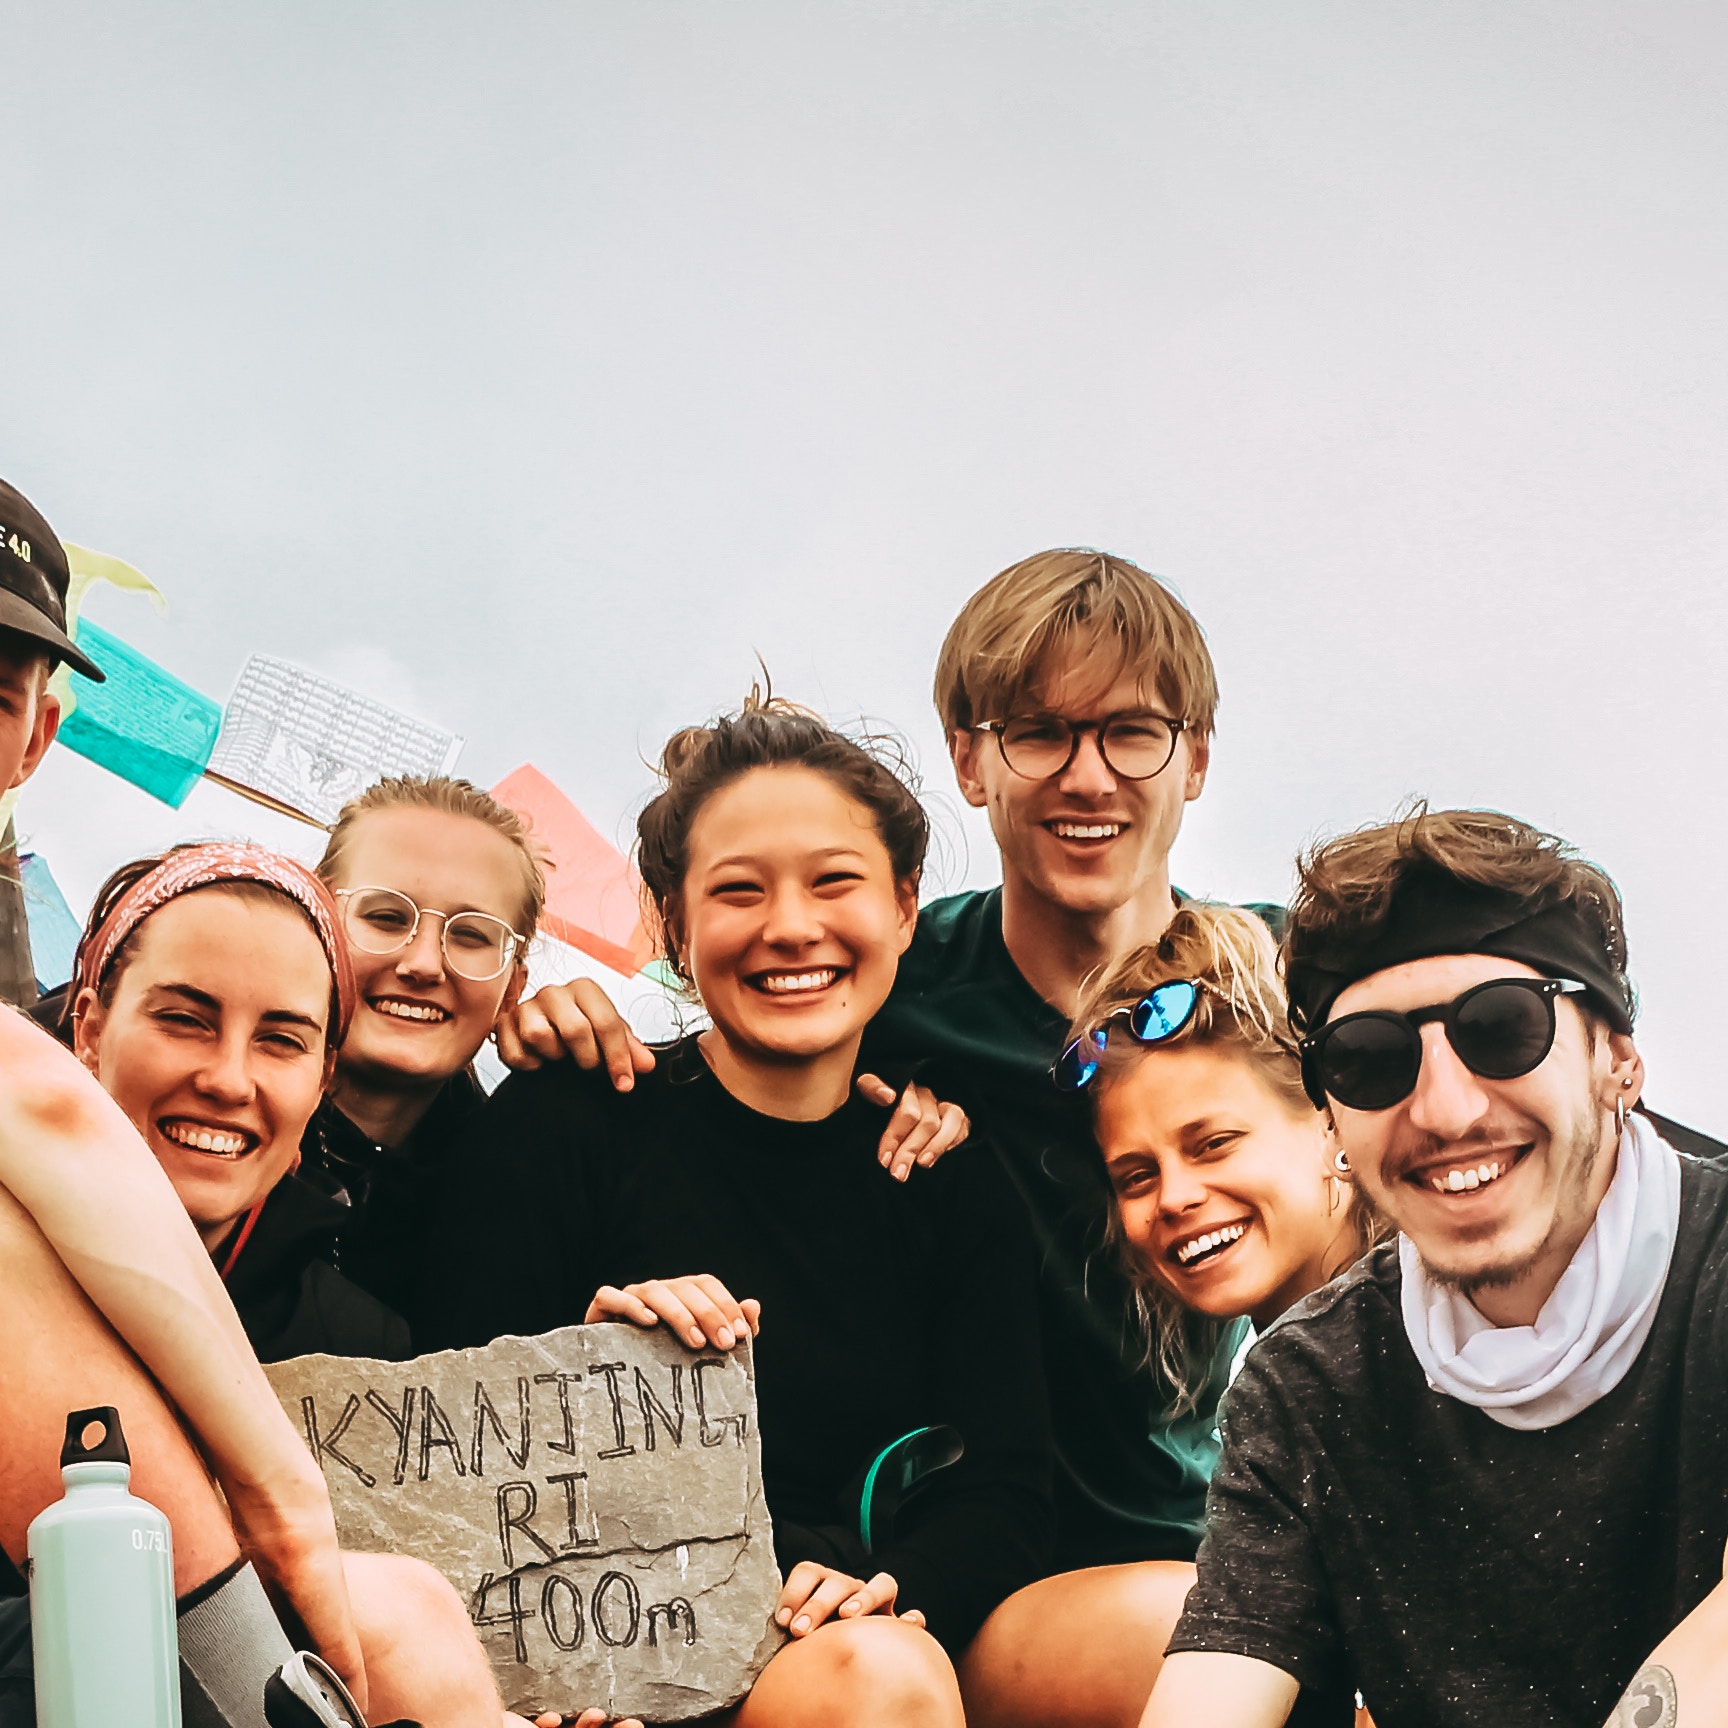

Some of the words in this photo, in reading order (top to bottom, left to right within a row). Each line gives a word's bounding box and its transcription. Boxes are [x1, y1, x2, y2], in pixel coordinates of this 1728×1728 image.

[8, 533, 31, 563] 4.0
[300, 1359, 748, 1489] KYANJING
[131, 1528, 170, 1553] 0.75L
[496, 1470, 601, 1569] RI
